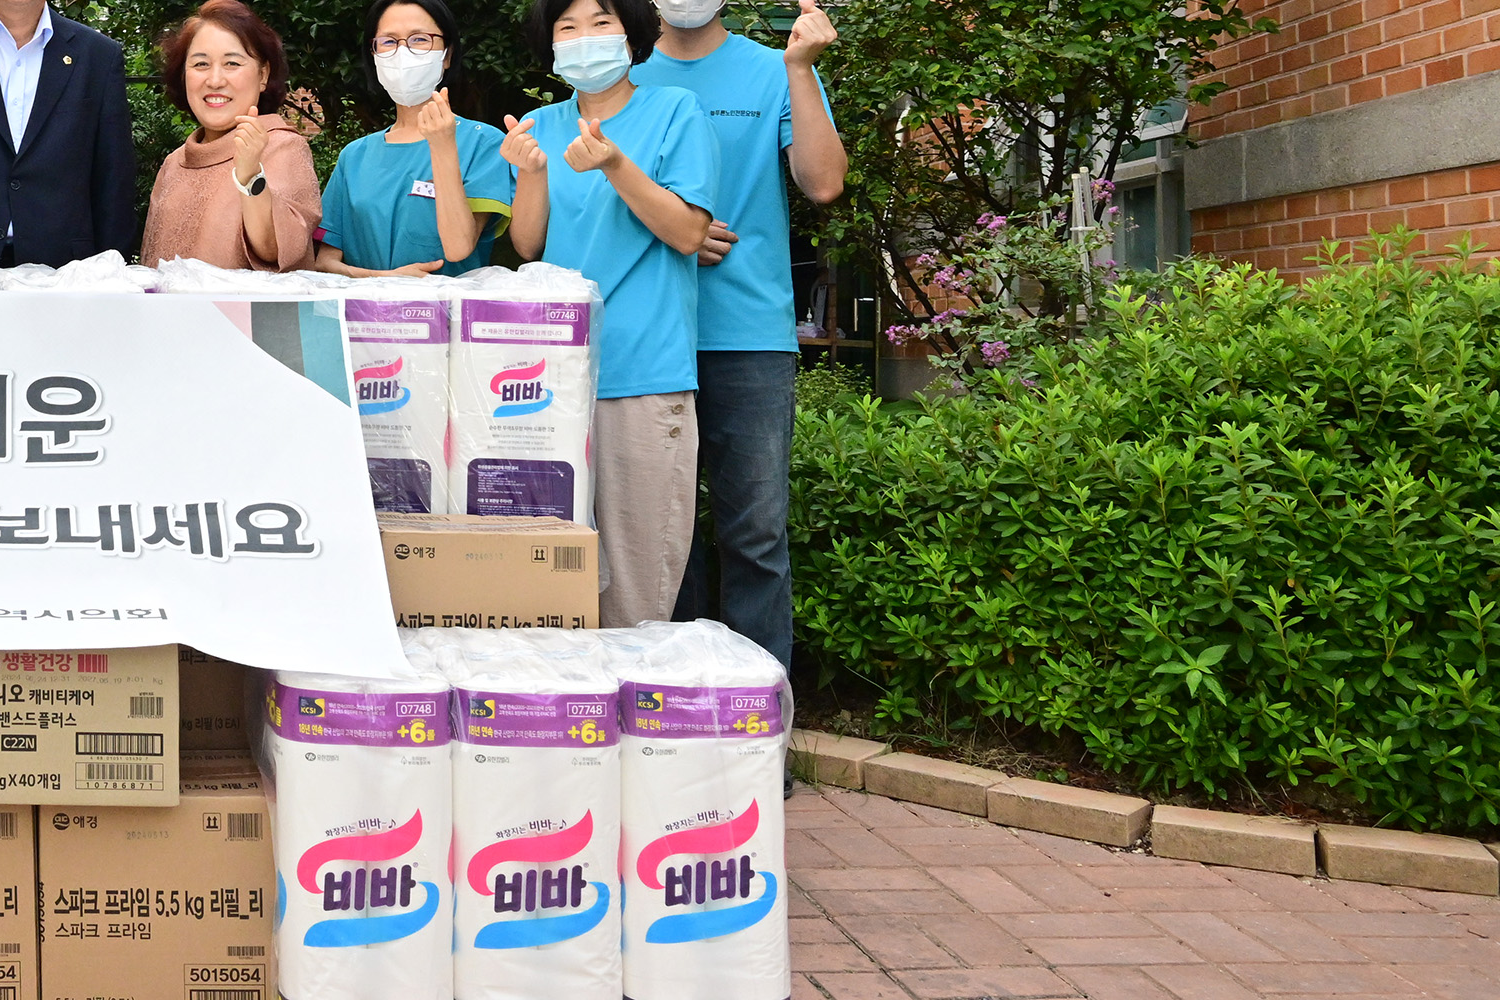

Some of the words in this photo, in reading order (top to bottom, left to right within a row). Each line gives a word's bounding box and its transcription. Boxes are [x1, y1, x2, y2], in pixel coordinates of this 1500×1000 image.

[405, 309, 432, 318] 07748
[549, 311, 575, 320] 07748
[359, 380, 400, 400] 비바
[502, 381, 542, 401] 비바
[413, 546, 436, 559] 애경
[2, 652, 73, 672] 생활건강
[29, 689, 94, 706] 캐비티케어
[735, 698, 767, 708] 07748
[400, 704, 432, 714] 07748
[571, 705, 603, 715] 07748
[638, 701, 654, 709] KCSI
[299, 723, 311, 734] 18년
[312, 724, 323, 736] 연속
[481, 725, 493, 737] 연속
[649, 718, 661, 730] 연속
[3, 737, 35, 749] C22N
[73, 815, 98, 829] 애경
[665, 816, 696, 832] 화장지는
[325, 824, 356, 838] 화장지는
[495, 825, 527, 839] 화장지는
[664, 855, 755, 906] 비바
[323, 864, 416, 912] 비바
[493, 865, 587, 912] 비바
[54, 887, 100, 917] 스파크
[104, 888, 150, 917] 프라임
[155, 890, 180, 917] 5.5
[185, 890, 205, 919] kg
[210, 888, 263, 919] 리필_리
[55, 922, 100, 939] 스파크
[107, 922, 151, 940] 프라임
[190, 968, 261, 983] 5015054
